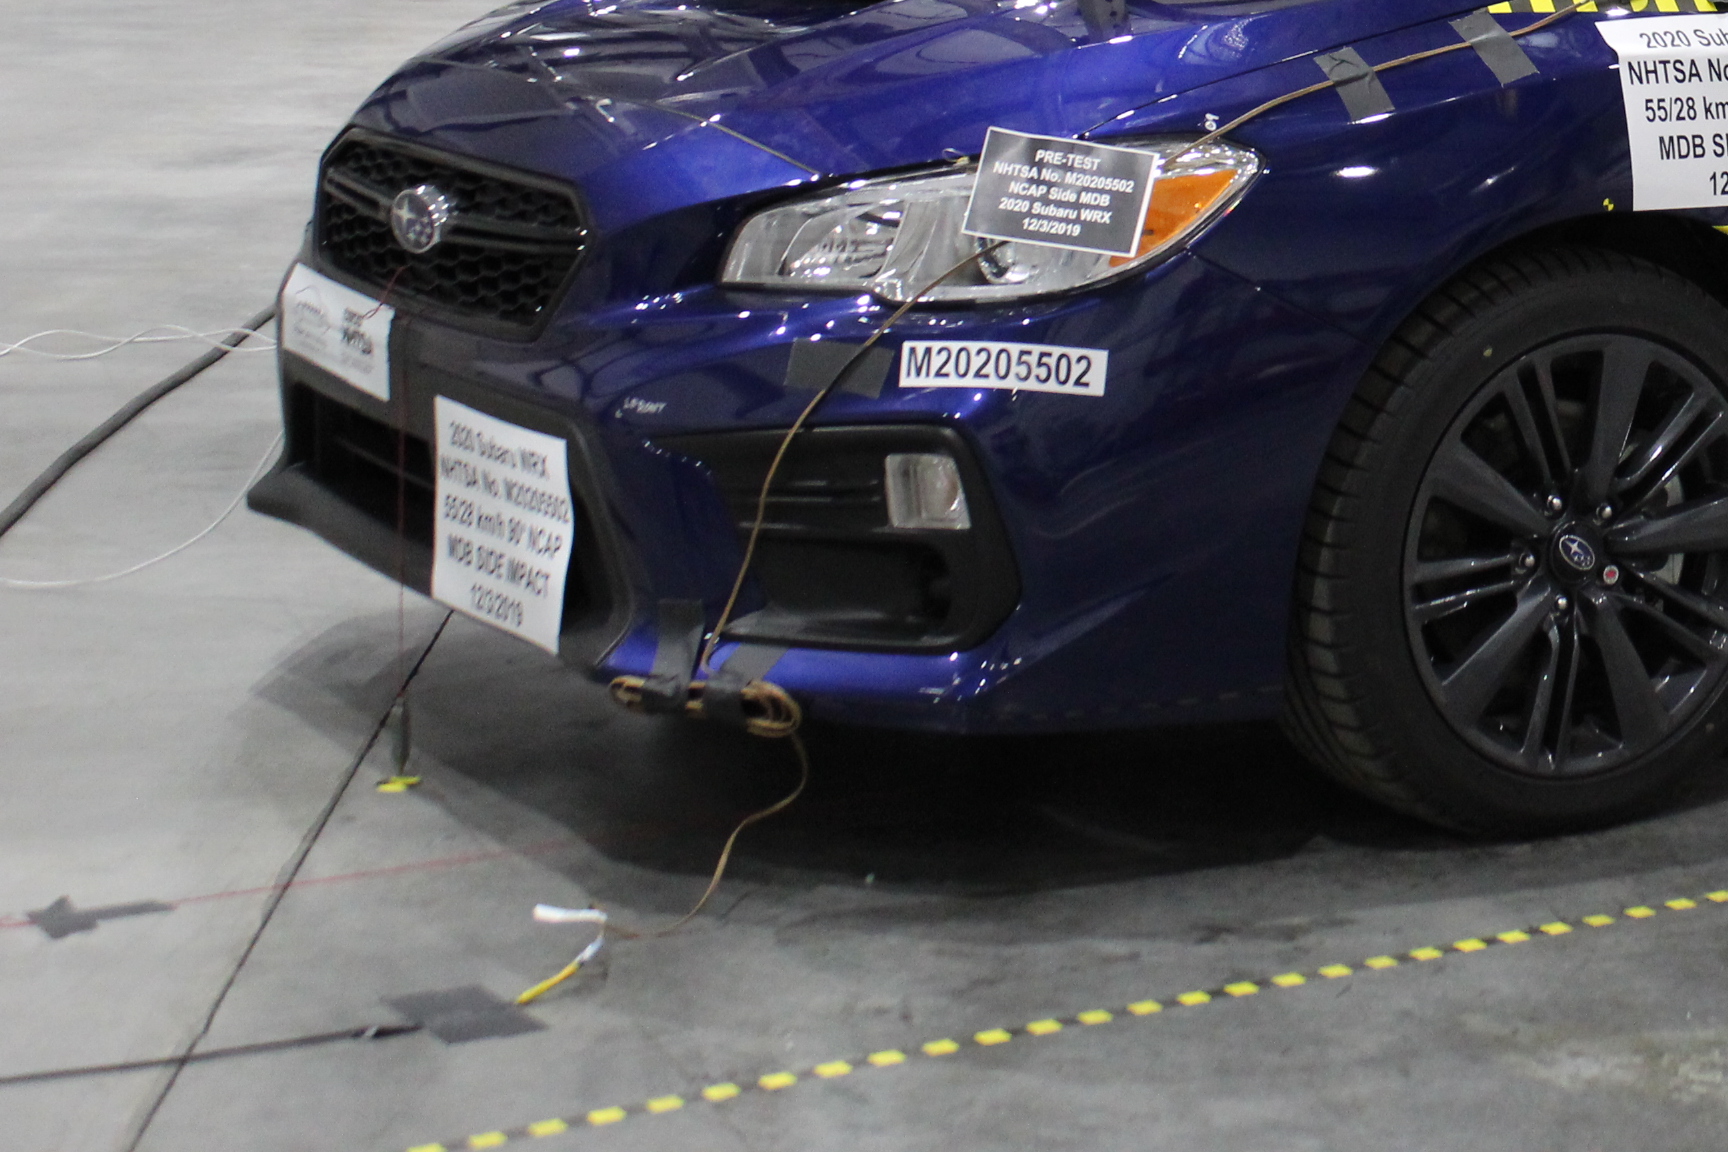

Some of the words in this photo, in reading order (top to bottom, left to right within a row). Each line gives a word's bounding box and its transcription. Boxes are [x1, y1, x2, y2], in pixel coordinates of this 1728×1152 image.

[1640, 30, 1692, 49] 2020
[1627, 58, 1703, 86] NHTSA
[1644, 96, 1698, 123] 55/28
[1034, 149, 1102, 171] PRE-TEST
[1658, 134, 1706, 161] MDB
[992, 160, 1039, 180] NHTSA
[1039, 168, 1062, 183] No.
[1064, 170, 1135, 194] M20205502
[1008, 180, 1048, 198] NCAP
[1048, 186, 1078, 203] Side
[1078, 191, 1111, 208] MDB
[998, 196, 1030, 213] 2020
[1031, 201, 1078, 219] Subaru
[1080, 207, 1113, 224] WRX
[1022, 217, 1082, 237] 12/3/2019
[905, 345, 1093, 389] M20205502
[526, 524, 563, 559] NCAP
[475, 544, 505, 580] SIDE
